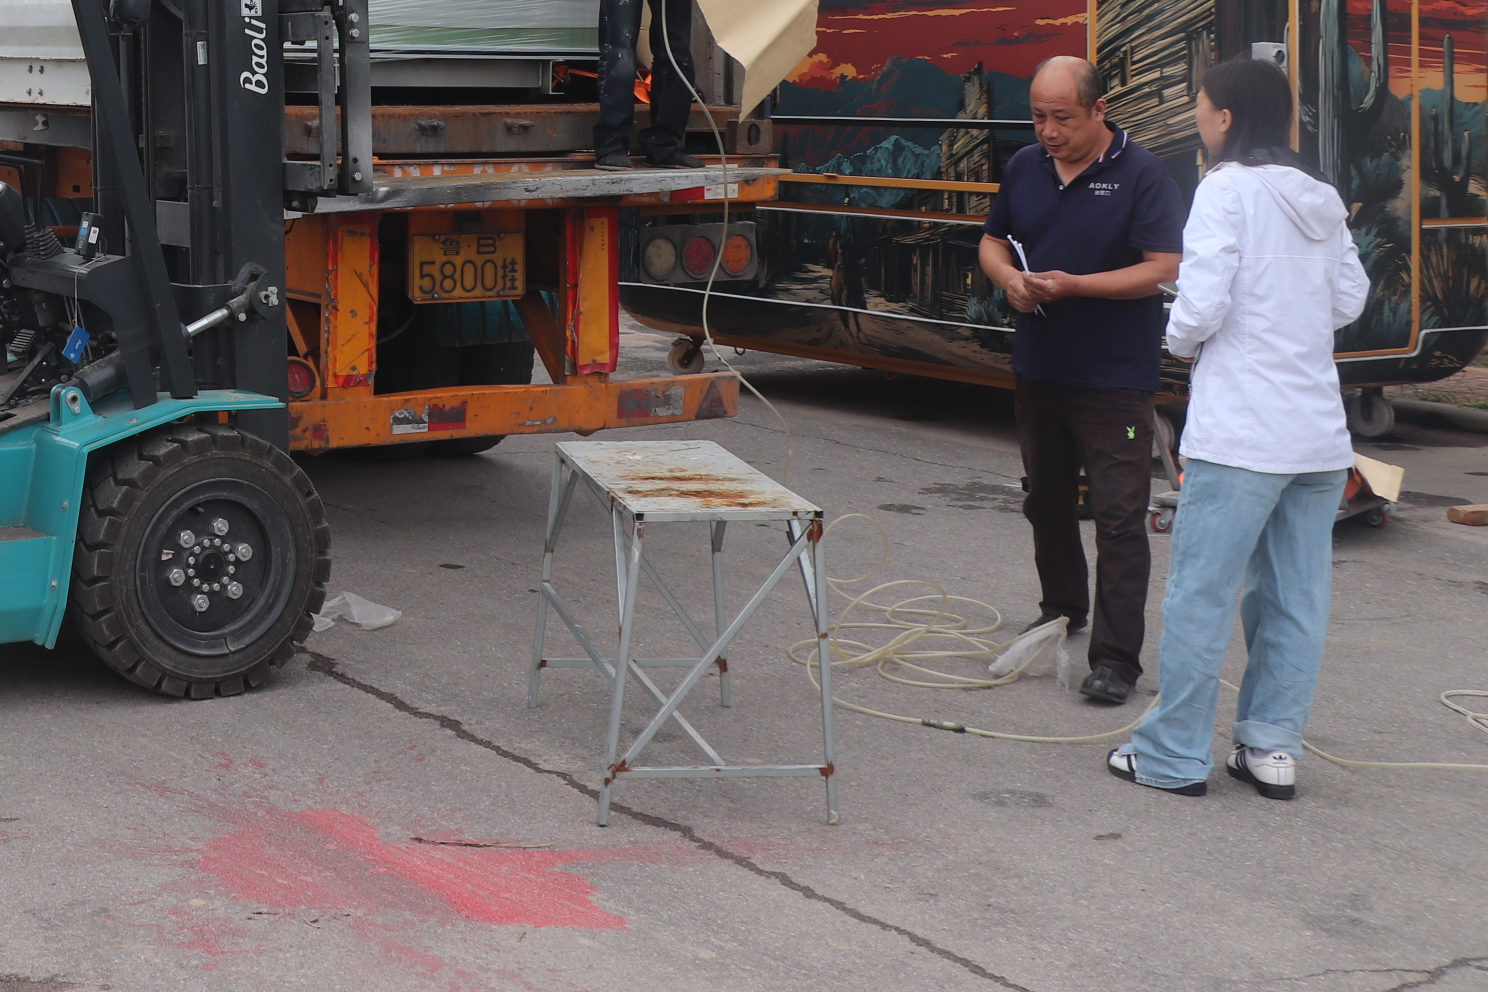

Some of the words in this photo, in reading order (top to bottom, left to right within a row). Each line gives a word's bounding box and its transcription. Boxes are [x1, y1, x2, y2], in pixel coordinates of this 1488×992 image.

[240, 17, 269, 95] Baoli
[1089, 182, 1120, 190] AOKLY
[419, 258, 518, 295] 5800挂
